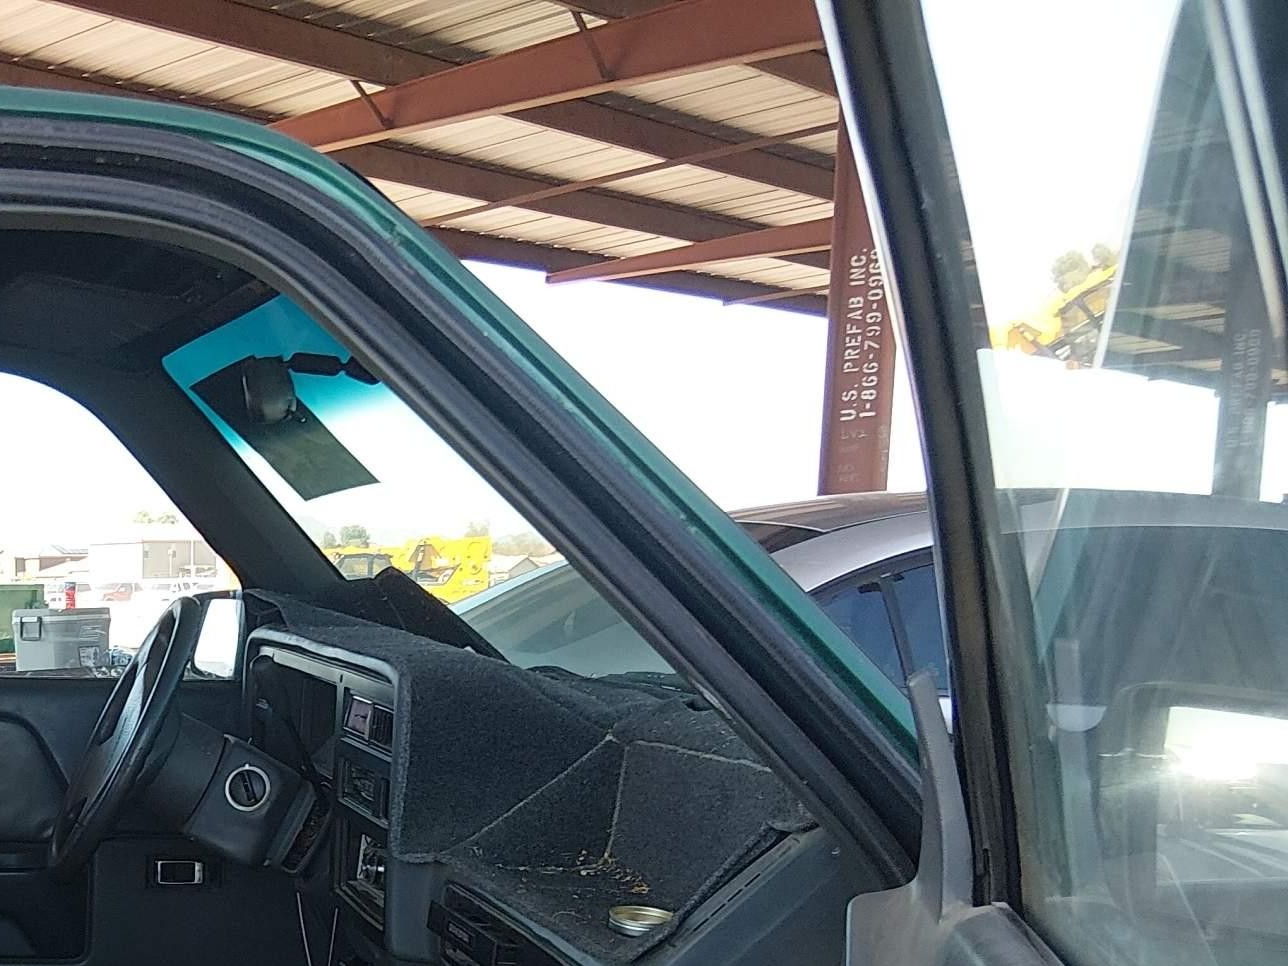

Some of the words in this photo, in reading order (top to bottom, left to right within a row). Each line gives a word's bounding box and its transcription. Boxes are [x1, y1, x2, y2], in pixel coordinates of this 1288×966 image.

[848, 247, 868, 286] INC.
[843, 296, 864, 373] PREFAB
[839, 384, 858, 421] U.S.
